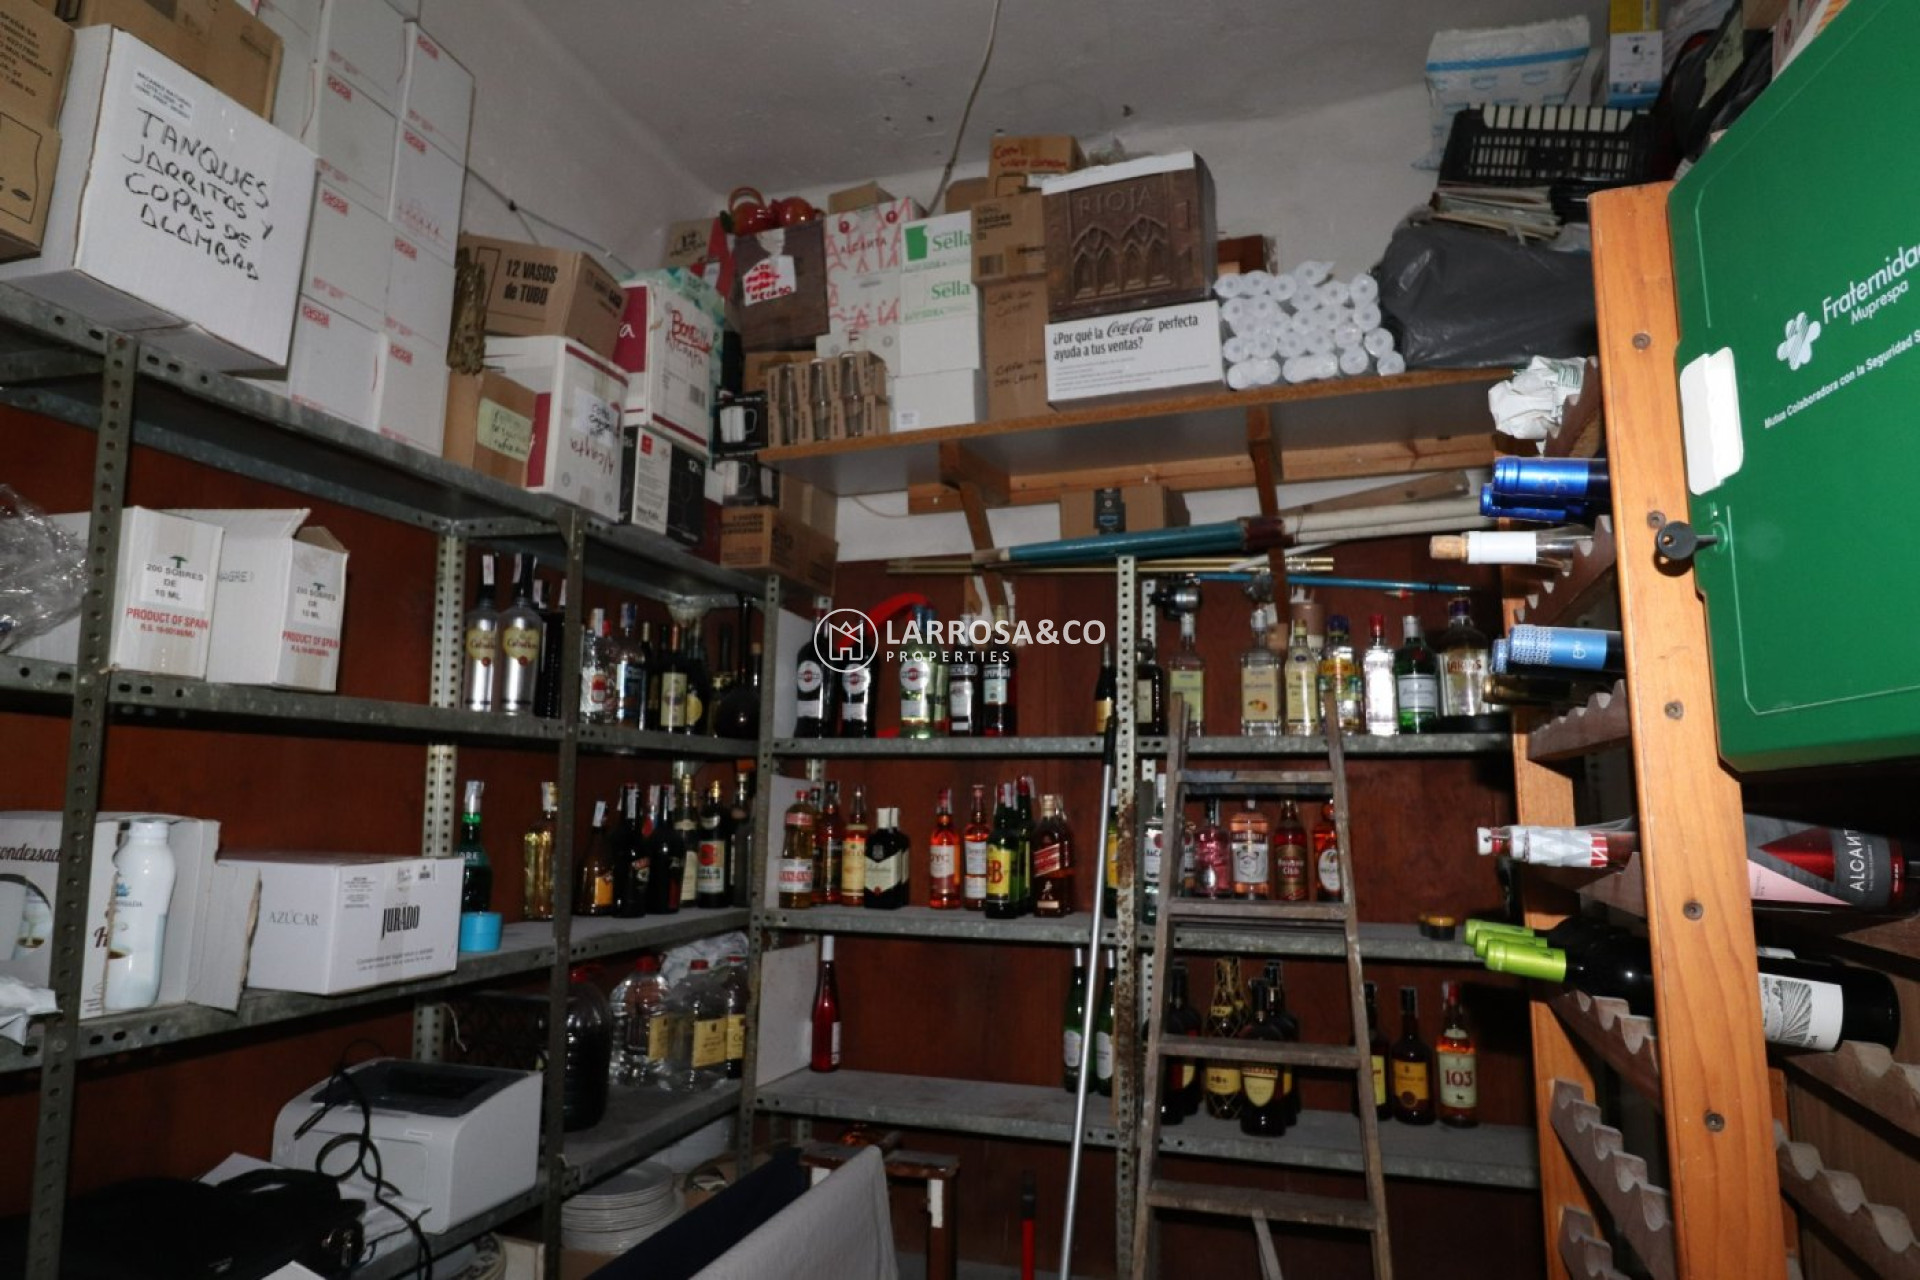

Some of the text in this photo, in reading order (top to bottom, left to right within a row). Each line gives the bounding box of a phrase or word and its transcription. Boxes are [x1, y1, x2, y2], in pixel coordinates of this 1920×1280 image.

[137, 107, 269, 208] TANQUES
[122, 144, 247, 219] JARRITOS
[125, 172, 251, 248] COPAS DE
[1079, 185, 1152, 216] RIOJA
[933, 230, 971, 251] Sella
[506, 259, 559, 283] 12 VASOS
[504, 283, 549, 306] de TUBO
[931, 280, 970, 300] Sella
[1851, 280, 1909, 325] Muprespa
[1053, 332, 1073, 346] ¿Por
[1075, 328, 1092, 344] qué
[1094, 327, 1104, 340] la
[1158, 314, 1198, 333] perfecta
[1054, 336, 1143, 361] ayuda a tus ventas?
[1764, 410, 1787, 429] Mutua
[1786, 380, 1839, 416] Colaboradora
[1839, 371, 1856, 387] con
[1856, 364, 1865, 377] la
[1865, 335, 1913, 371] Seguridad
[146, 563, 204, 581] 200 SOBRES
[163, 578, 176, 587] DE
[155, 589, 165, 598] 10
[126, 607, 208, 630] PRODUCT OF SPAIN
[282, 630, 339, 649] PRODUCT OF SPAIN
[269, 909, 319, 926] AZÚCAR
[381, 905, 420, 940] JURADO
[1445, 1069, 1473, 1087] 103
